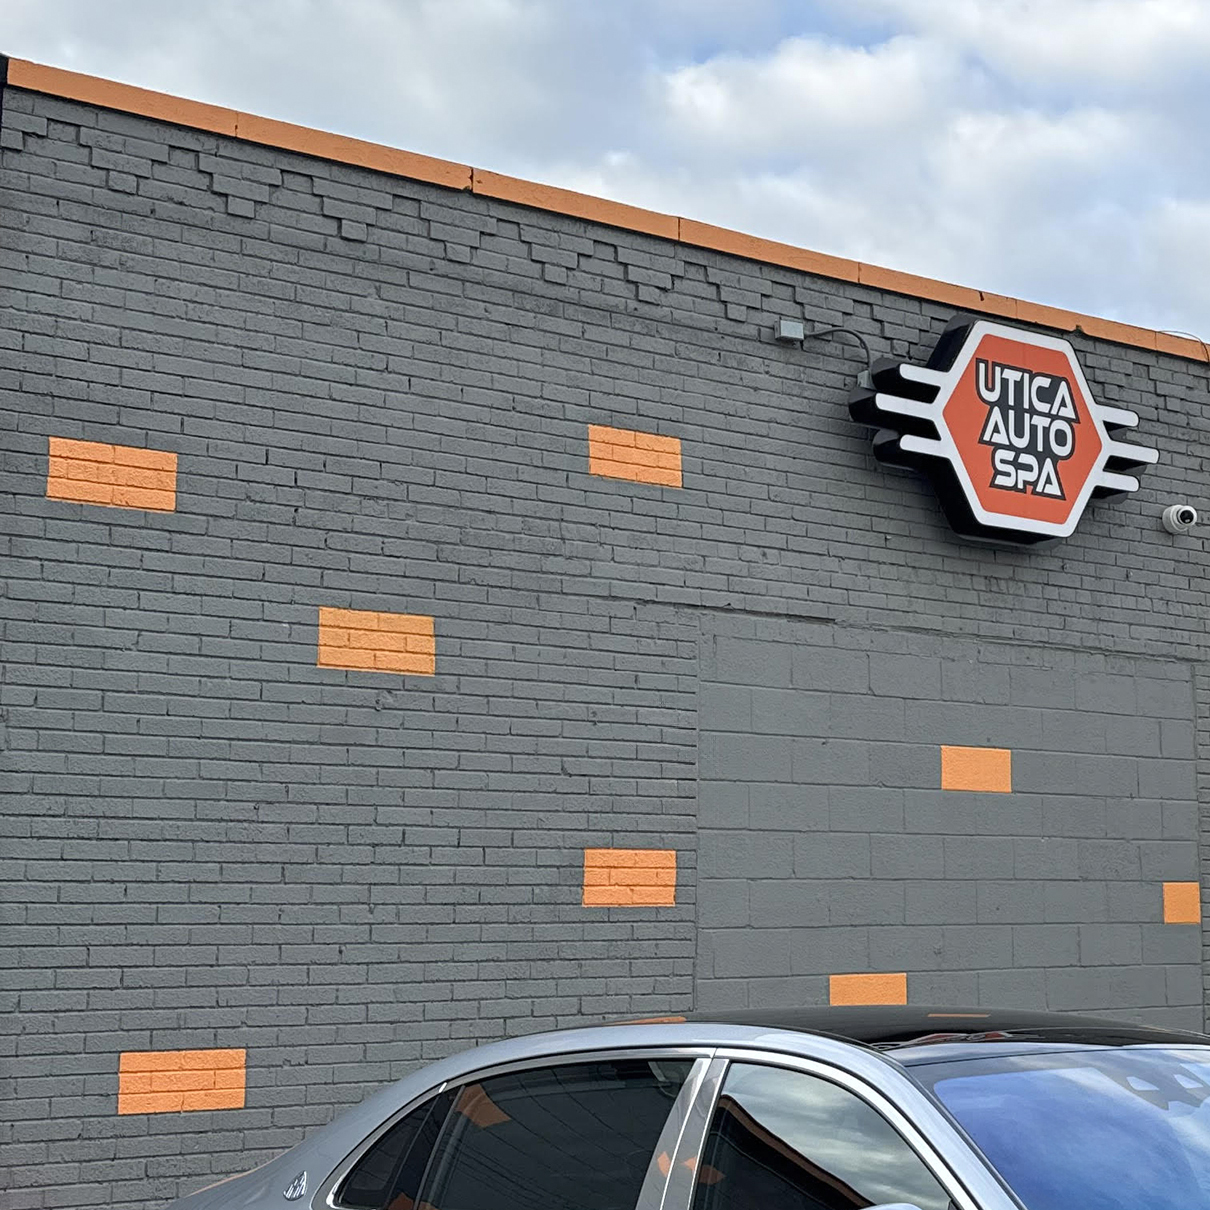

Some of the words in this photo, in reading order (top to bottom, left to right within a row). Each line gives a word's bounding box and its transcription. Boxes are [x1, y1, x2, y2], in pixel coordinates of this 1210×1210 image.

[978, 362, 1077, 420] UTICA
[982, 406, 1073, 457] AUTO
[993, 449, 1063, 496] SPA
